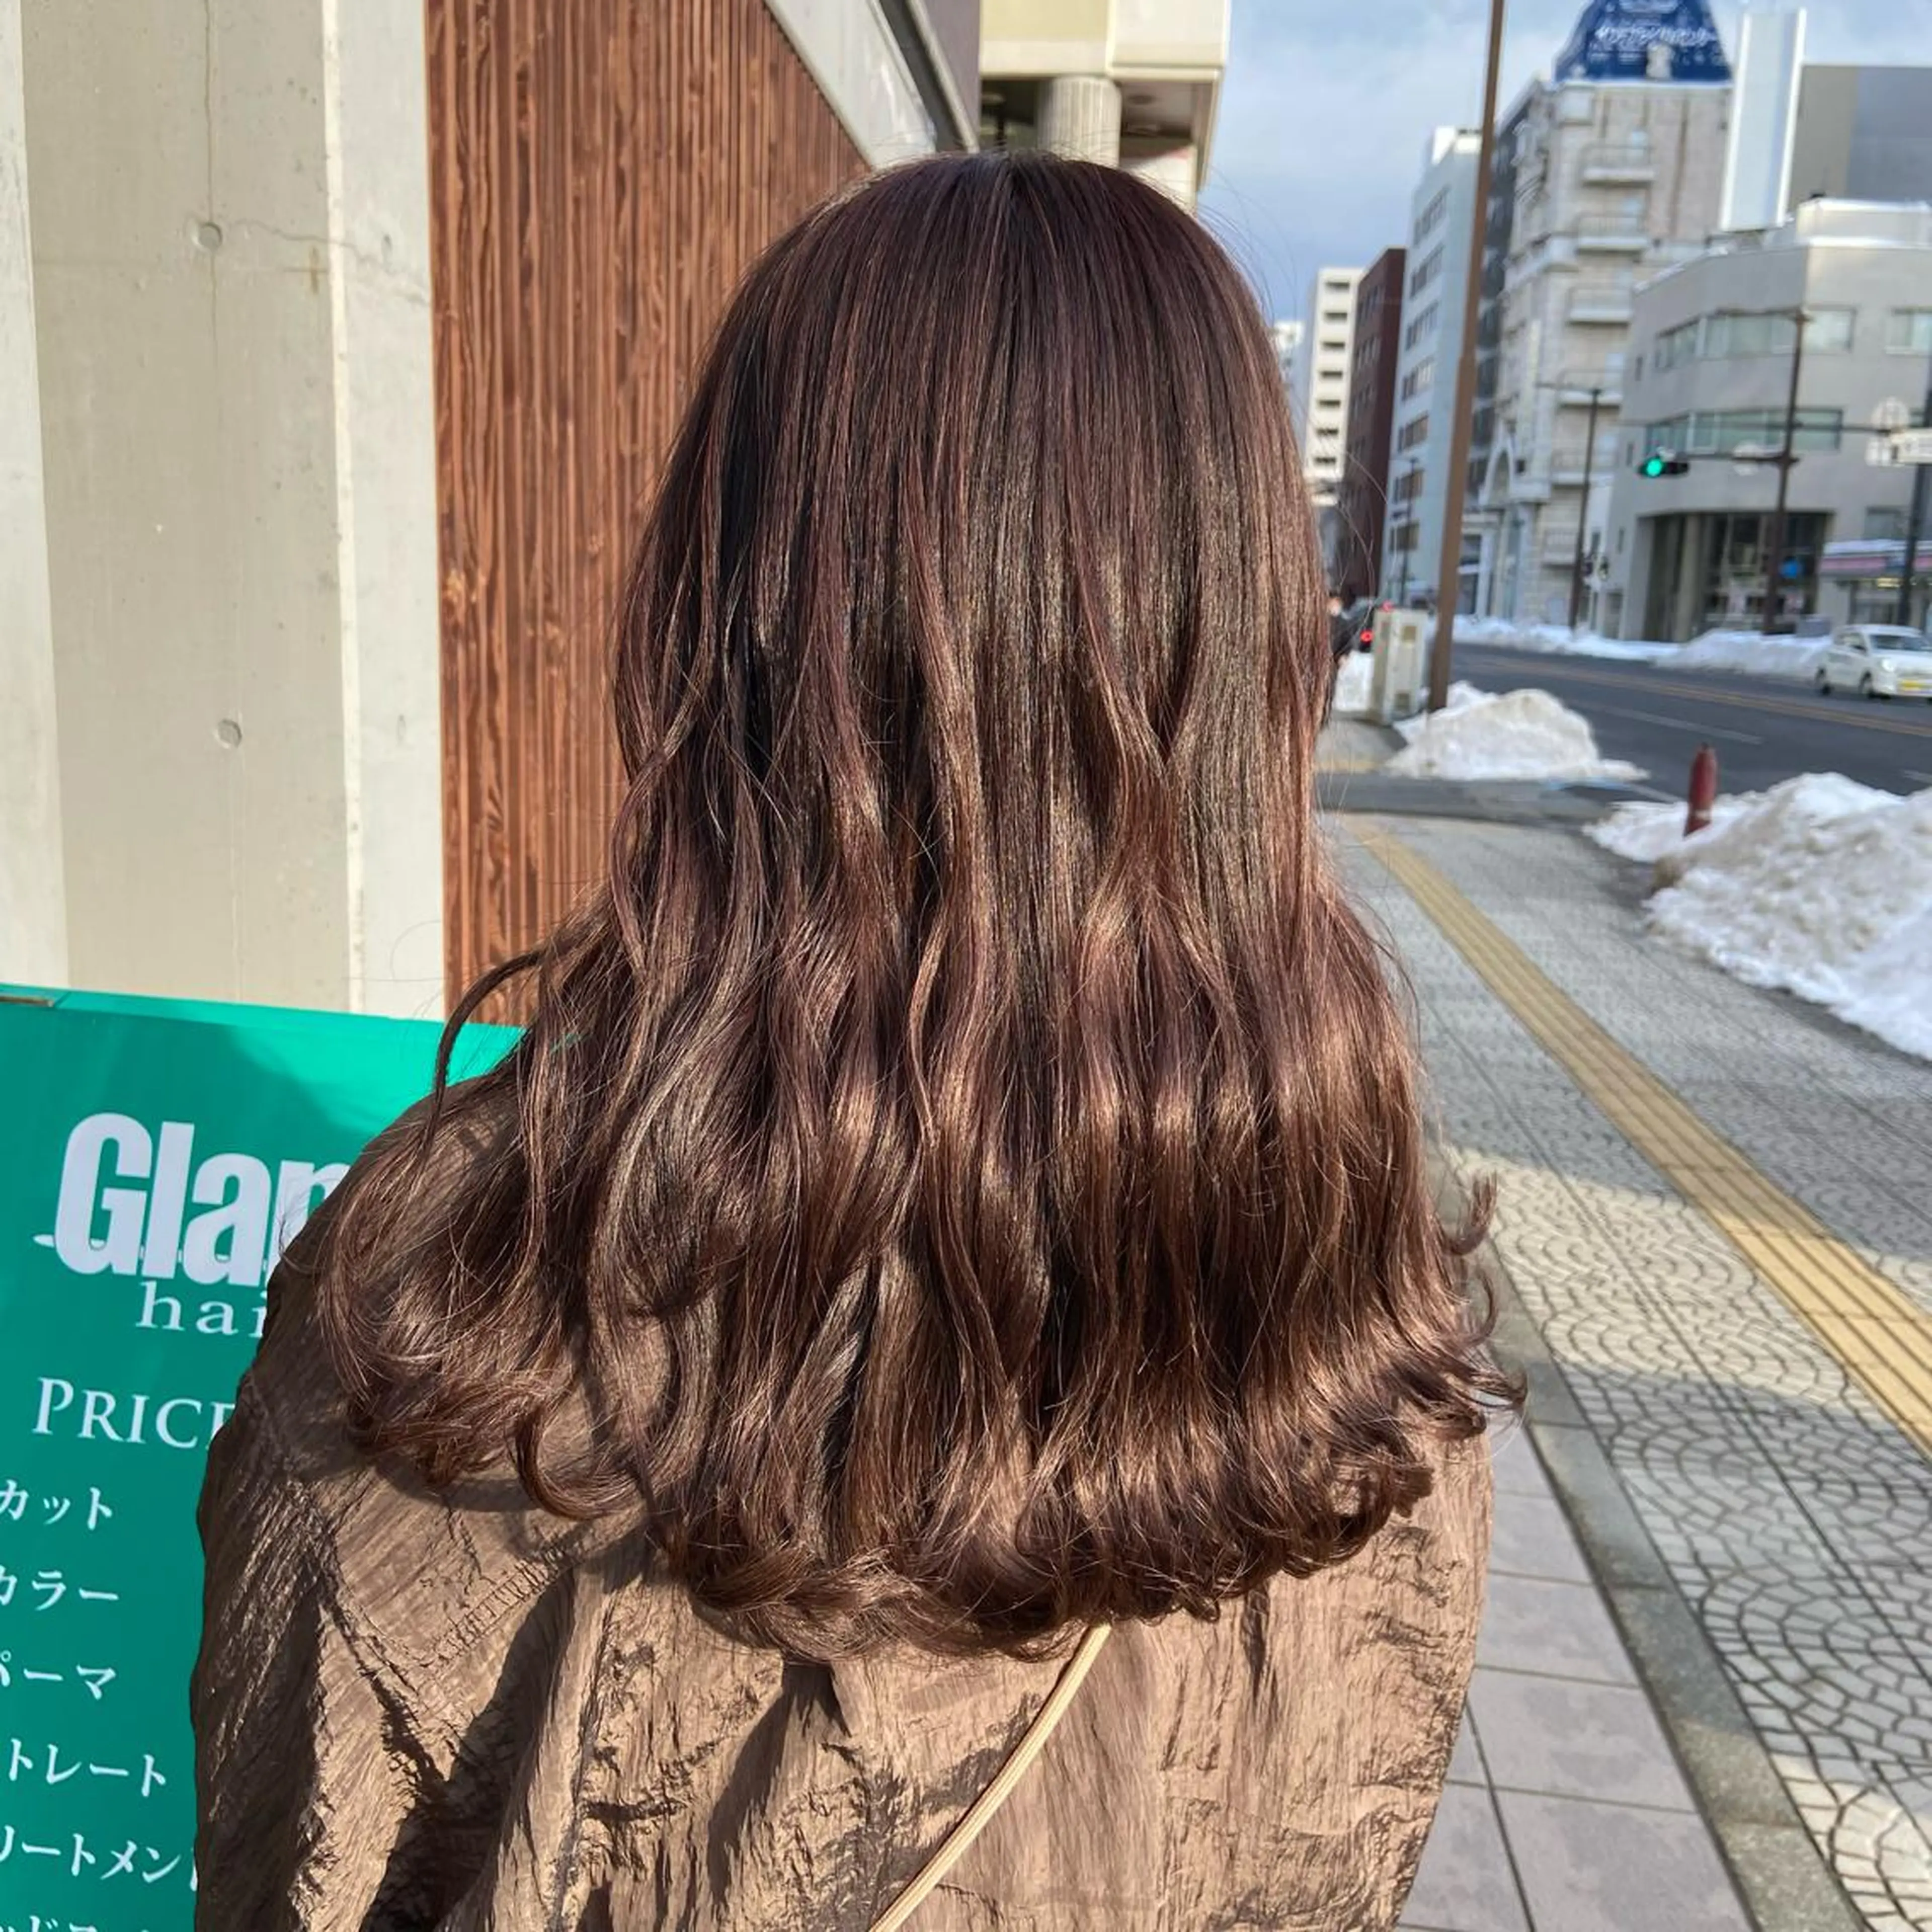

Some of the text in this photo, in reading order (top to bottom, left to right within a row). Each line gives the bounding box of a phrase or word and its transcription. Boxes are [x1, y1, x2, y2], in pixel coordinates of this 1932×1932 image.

[0, 1478, 113, 1530] カット
[8, 1738, 167, 1797] トレート
[0, 1825, 198, 1892] リートメン
